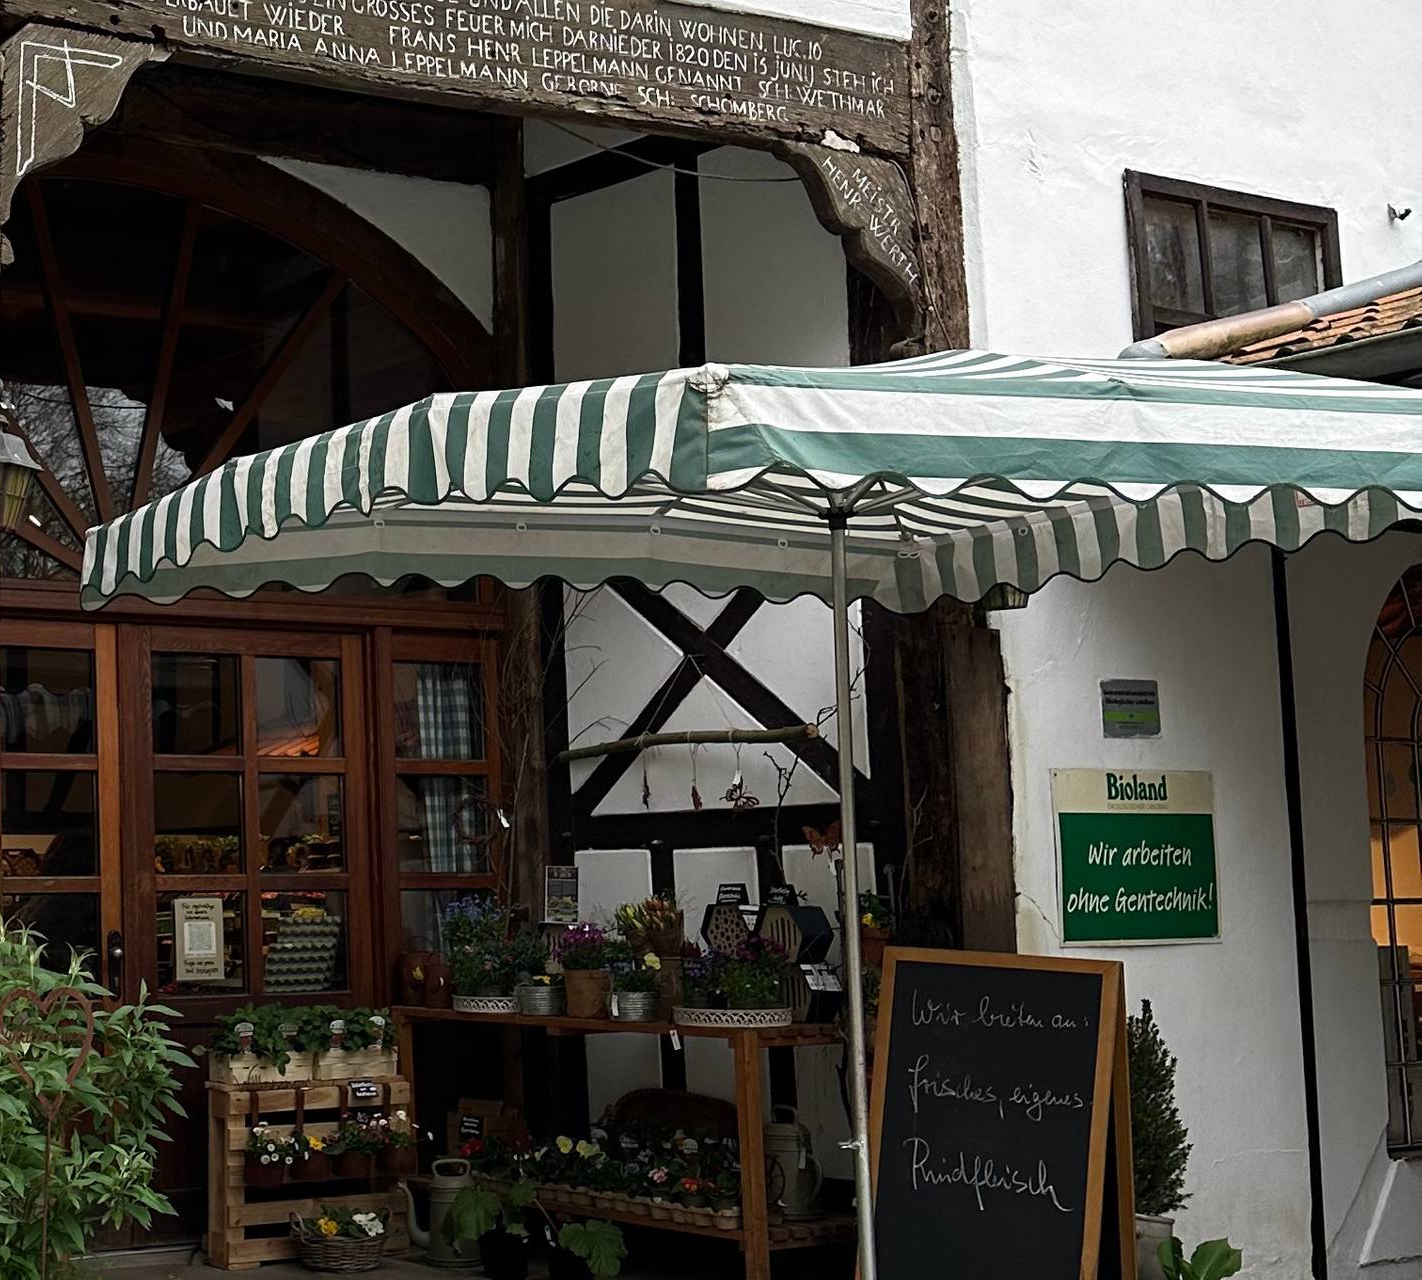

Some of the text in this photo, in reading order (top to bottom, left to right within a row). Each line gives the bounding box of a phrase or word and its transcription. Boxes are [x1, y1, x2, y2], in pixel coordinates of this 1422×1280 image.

[590, 0, 614, 28] DIE
[620, 10, 672, 37] DARIN
[183, 15, 228, 41] UND
[233, 25, 303, 52] MARIA
[315, 37, 380, 64] ANNA
[392, 51, 528, 88] LEPPELMANN
[637, 86, 676, 109] SCH:
[263, 2, 345, 35] WIEDER
[388, 25, 456, 54] FRANS
[532, 47, 649, 81] LEPPELMANN
[655, 65, 742, 92] GENANNT
[795, 84, 886, 119] WETHMAR
[352, 0, 435, 26] GROSSES
[445, 8, 506, 36] FEUER
[510, 15, 554, 43] MICH
[562, 26, 664, 61] DARNIEDER
[713, 49, 747, 73] DEN
[823, 68, 866, 93] STEH
[871, 72, 894, 96] ICH
[870, 214, 920, 285] WERTH
[1106, 772, 1168, 801] Bioland
[1088, 839, 1193, 867] Wir arbeiten
[1066, 882, 1214, 914] ohne Gentechnik!
[912, 988, 966, 1026] Wir
[973, 995, 1045, 1028] bieten
[903, 1137, 1074, 1212] Rindfleisch
